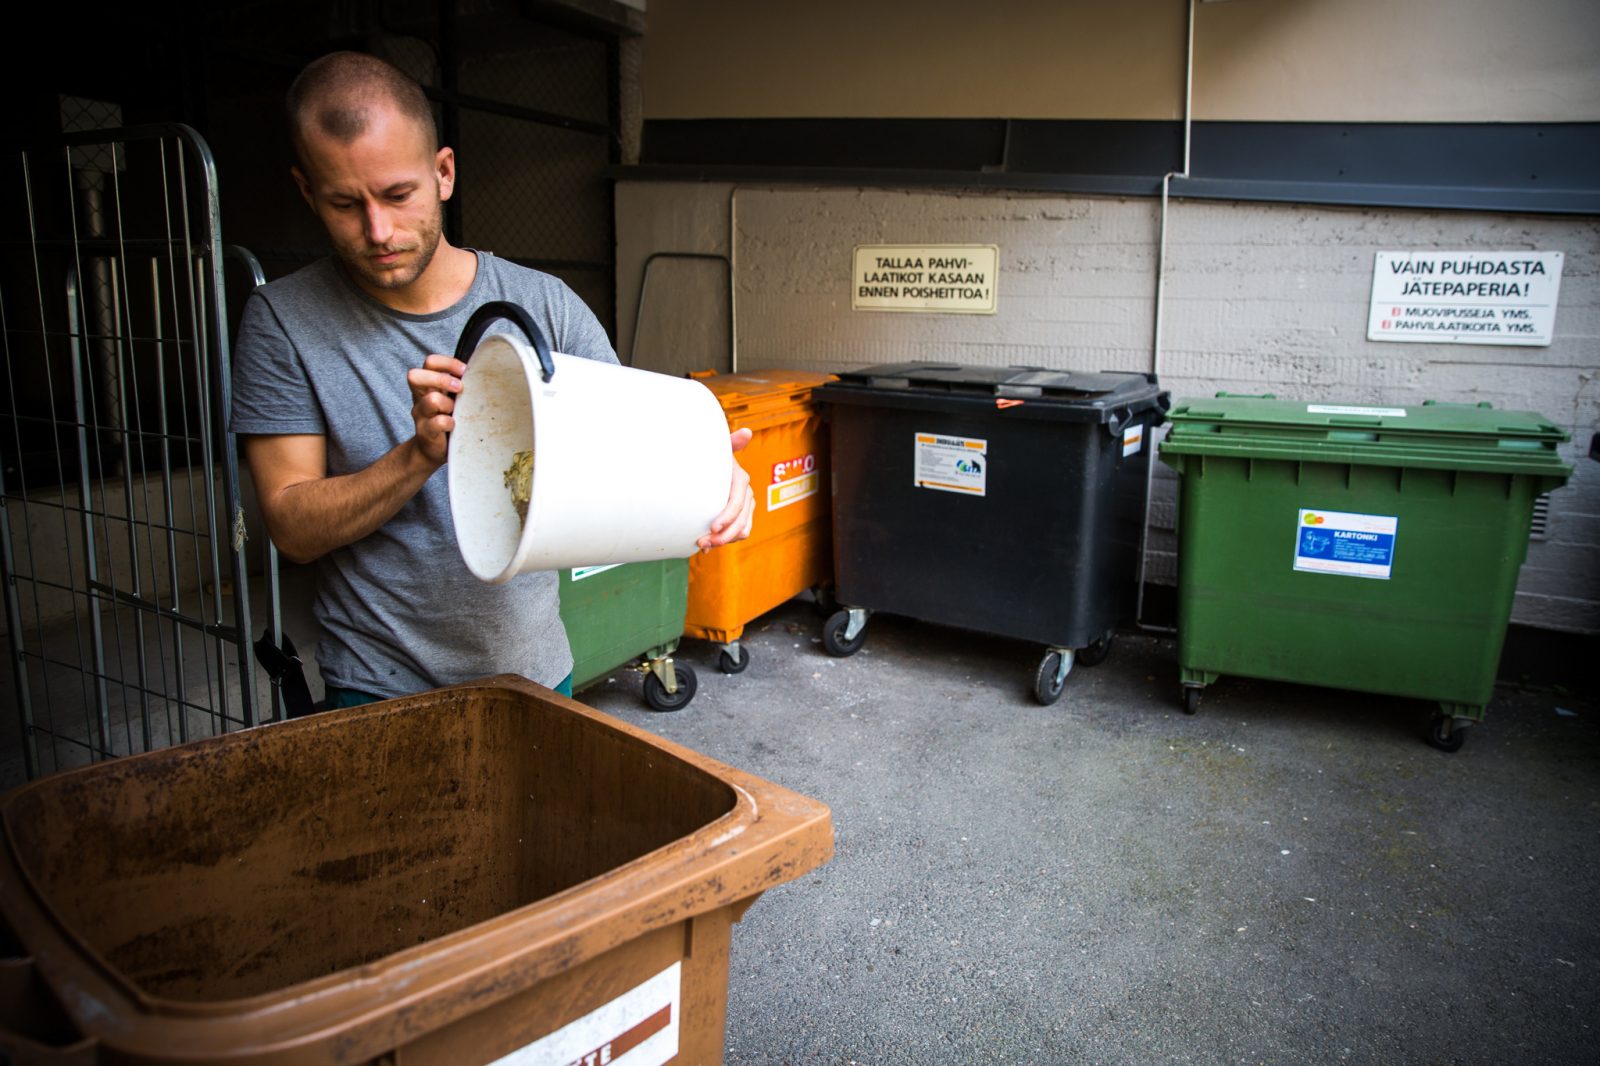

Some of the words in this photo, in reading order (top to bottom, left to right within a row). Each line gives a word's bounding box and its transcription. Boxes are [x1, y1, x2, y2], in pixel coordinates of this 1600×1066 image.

[875, 257, 924, 269] TALLAA
[928, 257, 973, 269] PAHVI-
[1390, 260, 1435, 275] VAIN
[1440, 260, 1546, 275] PUHDASTA
[864, 272, 924, 284] LAATIKOT
[928, 273, 985, 285] KASAAN
[858, 286, 899, 298] ENNEN
[1401, 276, 1531, 297] JÄTEPAPERIA!
[1391, 306, 1402, 317] EI
[1405, 307, 1496, 318] MUOVIPUSSEJA
[1501, 309, 1532, 320] YMS.
[1381, 319, 1392, 330] EI
[1395, 320, 1501, 332] PAHVILAATIKOITA
[1506, 322, 1537, 333] YMS.
[1333, 530, 1378, 542] KARTONKI
